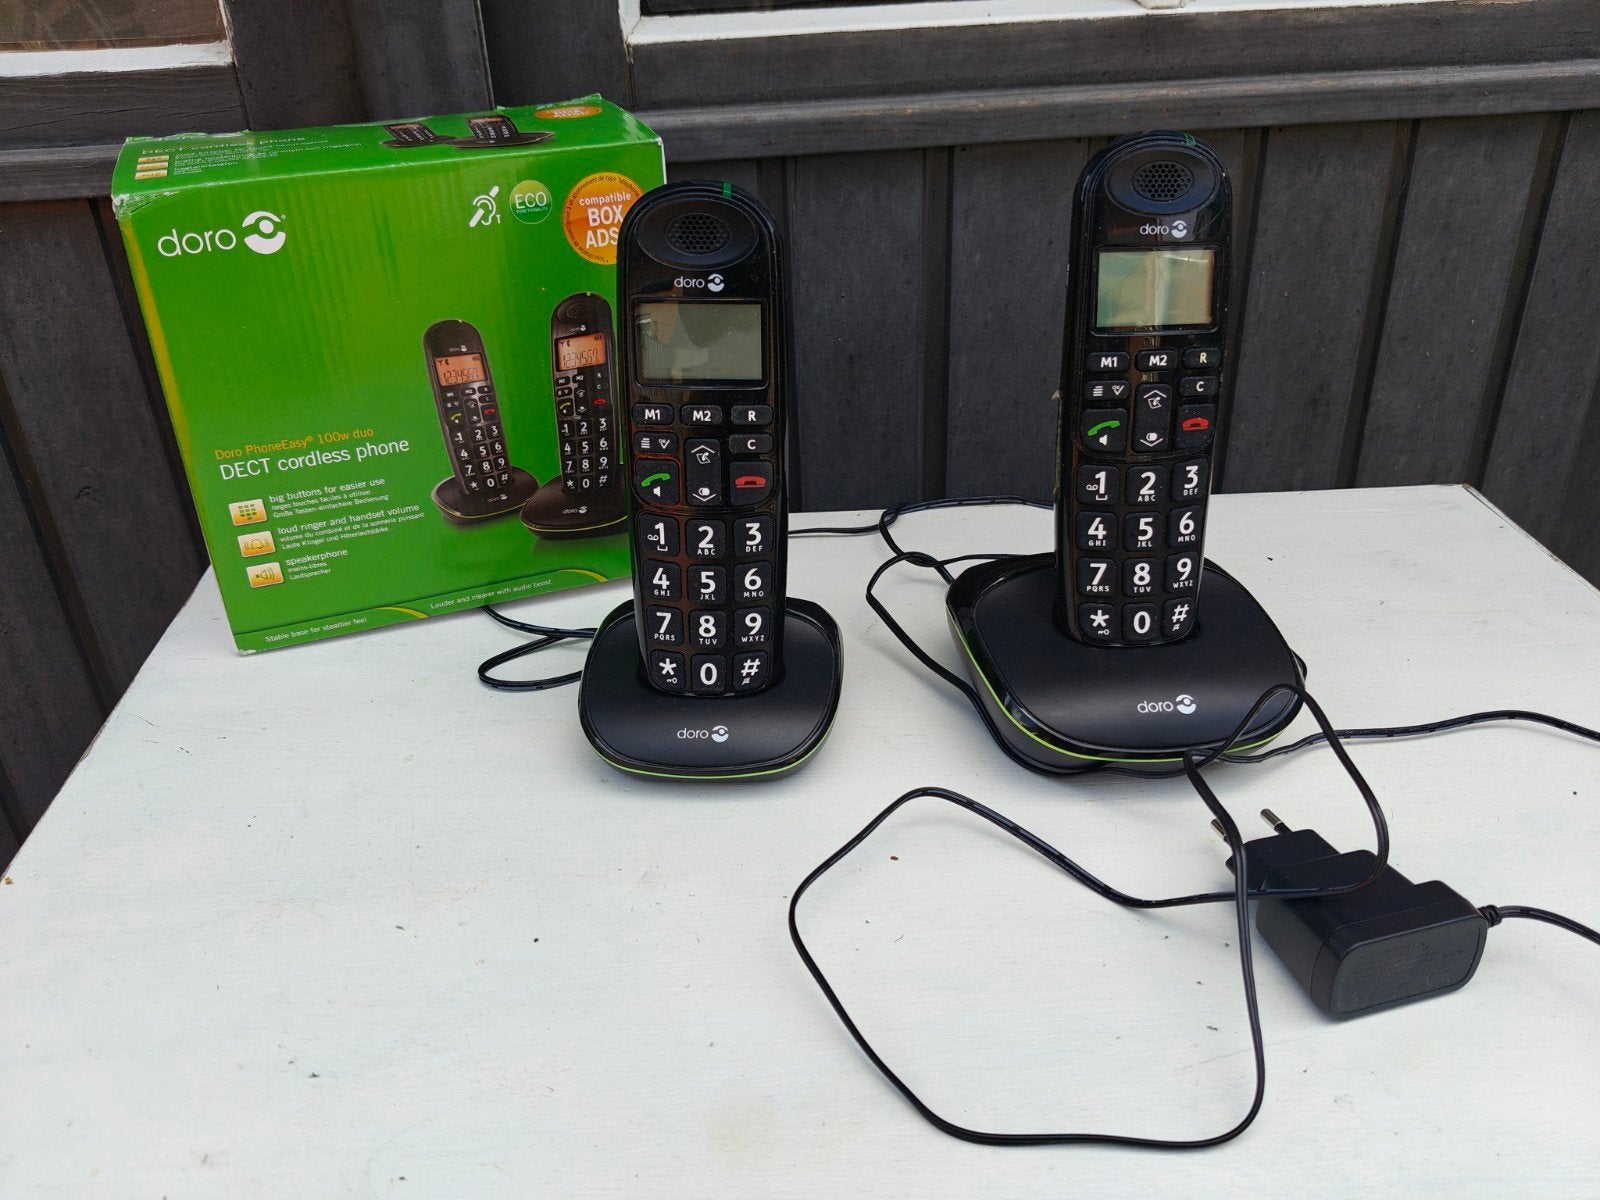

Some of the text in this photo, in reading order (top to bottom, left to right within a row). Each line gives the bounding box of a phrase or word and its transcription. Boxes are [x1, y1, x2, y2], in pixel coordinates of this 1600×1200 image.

[515, 192, 547, 209] ECO
[579, 191, 631, 206] compatible
[587, 205, 623, 227] BOX
[1139, 223, 1169, 235] doro
[158, 228, 237, 257] doro
[585, 227, 620, 249] ADS
[673, 276, 705, 289] doro
[1100, 352, 1207, 368] M1 M2 R
[1196, 381, 1204, 392] C
[644, 409, 756, 423] M1 M2 R
[456, 432, 463, 441] 1
[475, 430, 482, 439] 2
[491, 425, 498, 434] 3
[563, 423, 569, 433] 1
[580, 422, 587, 432] 2
[599, 418, 607, 428] 3
[214, 449, 242, 460] Doro
[318, 431, 349, 445] 100w
[353, 428, 374, 439] duo
[461, 442, 502, 457] 4 5 6
[564, 442, 571, 452] 4
[582, 441, 589, 452] 5
[599, 438, 608, 448] 6
[747, 439, 756, 450] C
[219, 440, 410, 480] DECT cordless phone
[465, 458, 505, 474] 7 8 9
[566, 460, 572, 471] 7
[582, 459, 589, 469] 8
[600, 456, 608, 467] 9
[487, 473, 508, 487] 0 #
[582, 475, 608, 488] 0 #
[1095, 465, 1199, 495] 1 2 3
[269, 495, 285, 503] big
[287, 489, 322, 500] buttons
[340, 481, 367, 492] easier
[369, 478, 385, 487] use
[1137, 488, 1199, 502] ABC DEF
[292, 499, 319, 508] touches
[354, 494, 389, 505] Bedienung
[277, 504, 420, 535] loud ringer and handset volume
[1087, 511, 1195, 541] 4 5 6
[280, 534, 303, 542] volume
[654, 522, 761, 548] 1 2 3
[1137, 540, 1152, 548] JKL
[1178, 534, 1196, 542] MNO
[282, 541, 301, 550] Laute
[697, 545, 763, 556] ABC DEF
[286, 549, 348, 566] speakerphone
[290, 569, 331, 580] Lautsprecher
[1089, 557, 1192, 586] 7 8 9
[653, 568, 762, 593] 4 5 6
[1086, 585, 1110, 593] PQRS
[1172, 580, 1194, 588] WXYZ
[430, 600, 454, 609] Louder
[471, 591, 495, 600] clearer
[496, 587, 512, 595] with
[513, 584, 531, 592] audio
[533, 579, 551, 588] boost
[654, 589, 671, 597] GHI
[743, 590, 764, 598] MNO
[656, 612, 762, 638] 7 8 9
[1133, 604, 1189, 634] 0 #
[265, 634, 289, 643] Stable
[291, 629, 309, 638] base
[322, 621, 351, 631] steadier
[353, 617, 367, 625] feel
[654, 633, 675, 641] PQRS
[741, 635, 765, 643] WXYZ
[700, 658, 760, 685] 0 #
[1137, 700, 1174, 714] doro
[677, 727, 709, 739] doro
